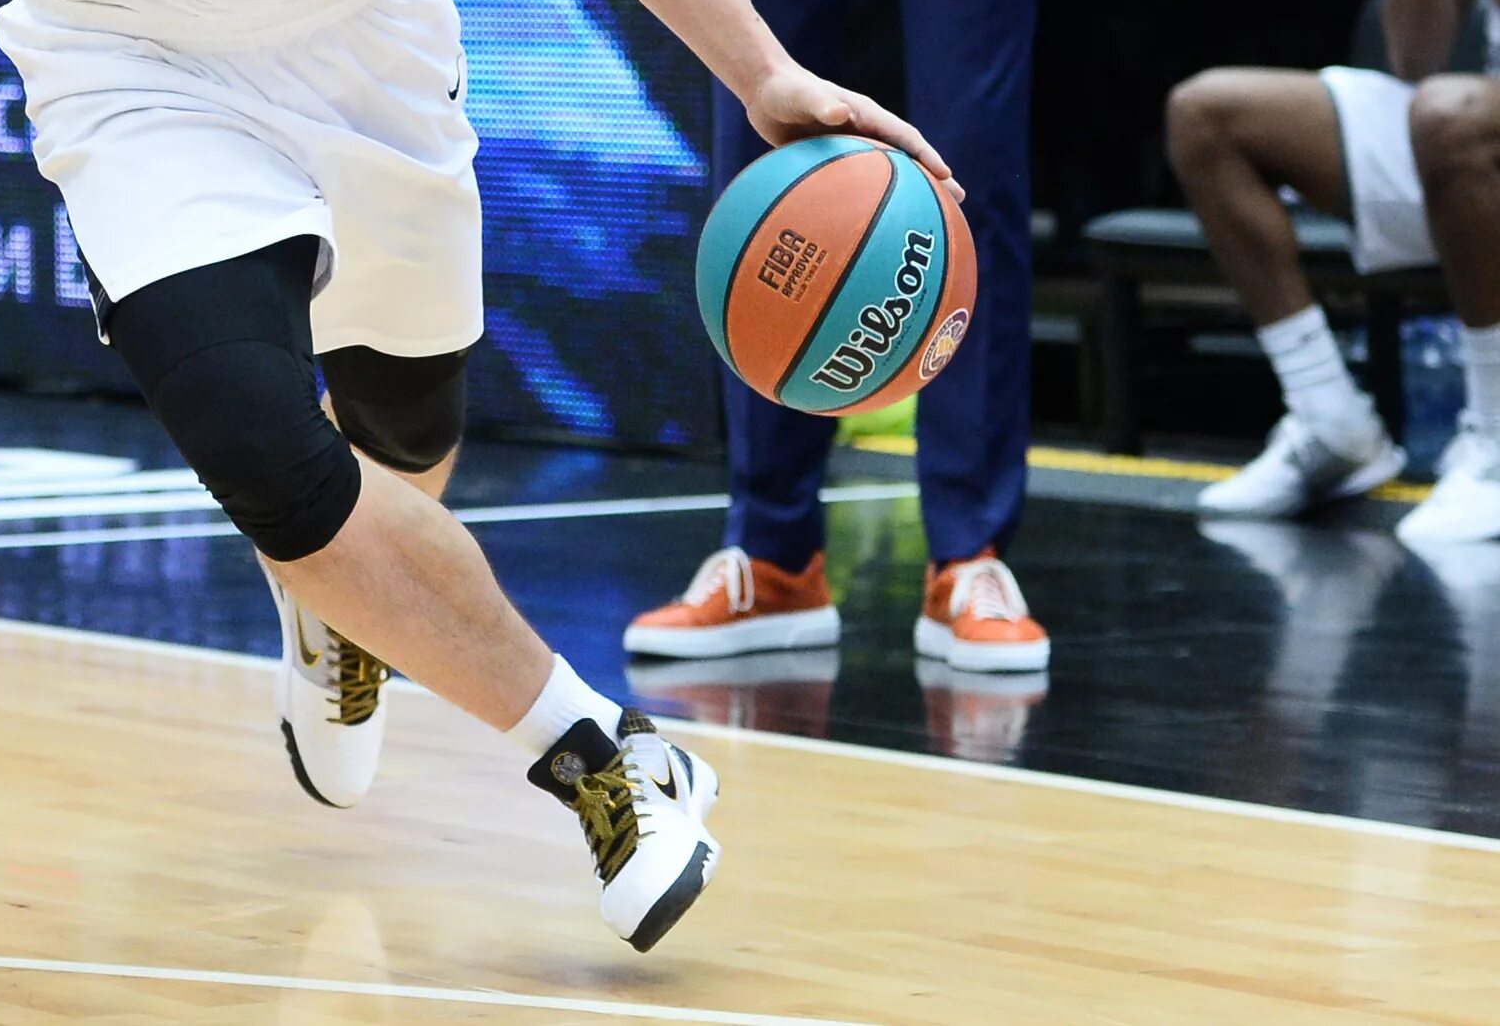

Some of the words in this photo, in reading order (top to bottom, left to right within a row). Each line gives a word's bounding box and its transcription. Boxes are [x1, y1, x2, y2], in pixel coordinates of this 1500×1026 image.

[757, 228, 806, 290] FIBA
[781, 242, 818, 298] APPROVED
[809, 228, 936, 392] Wilson
